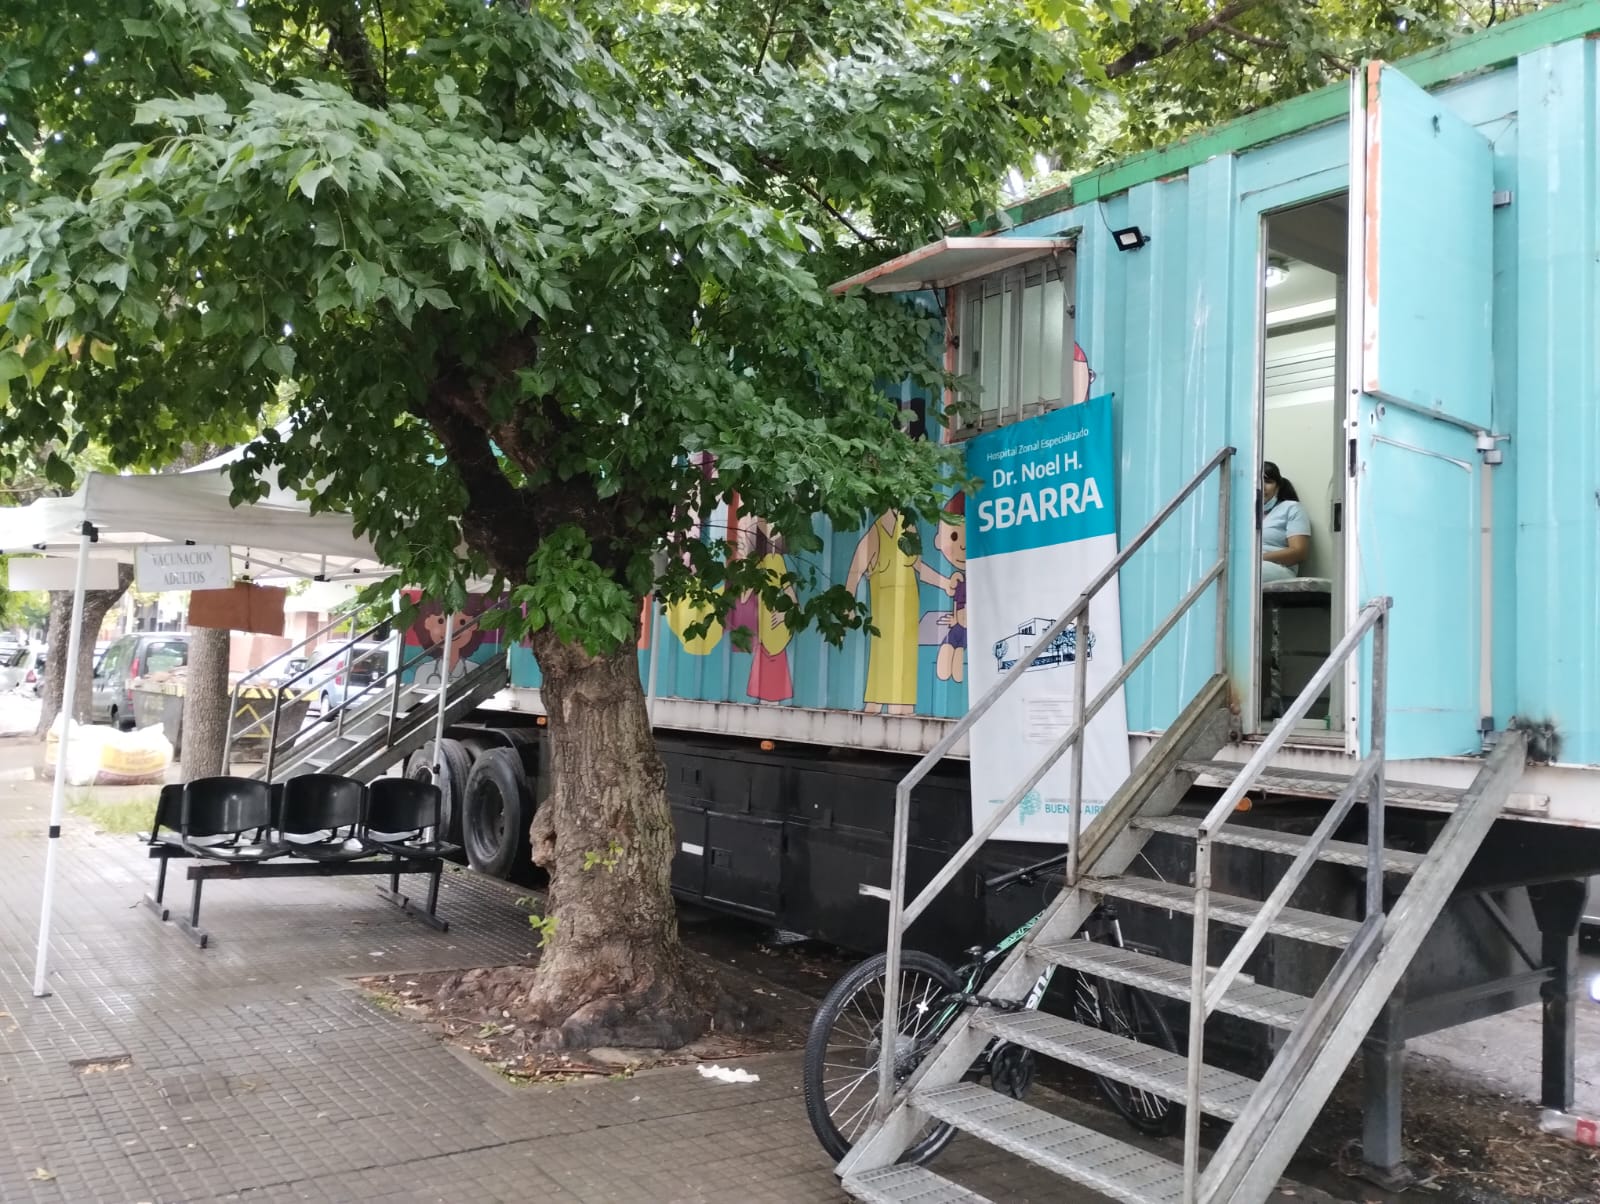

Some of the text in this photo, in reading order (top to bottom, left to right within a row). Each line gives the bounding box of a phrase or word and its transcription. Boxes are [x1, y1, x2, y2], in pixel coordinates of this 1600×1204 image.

[987, 427, 1089, 461] Hospital Zonal Especializado
[993, 451, 1083, 488] Dr. Noel H.
[978, 477, 1104, 532] SBARRA
[164, 570, 206, 586] ADULTOS
